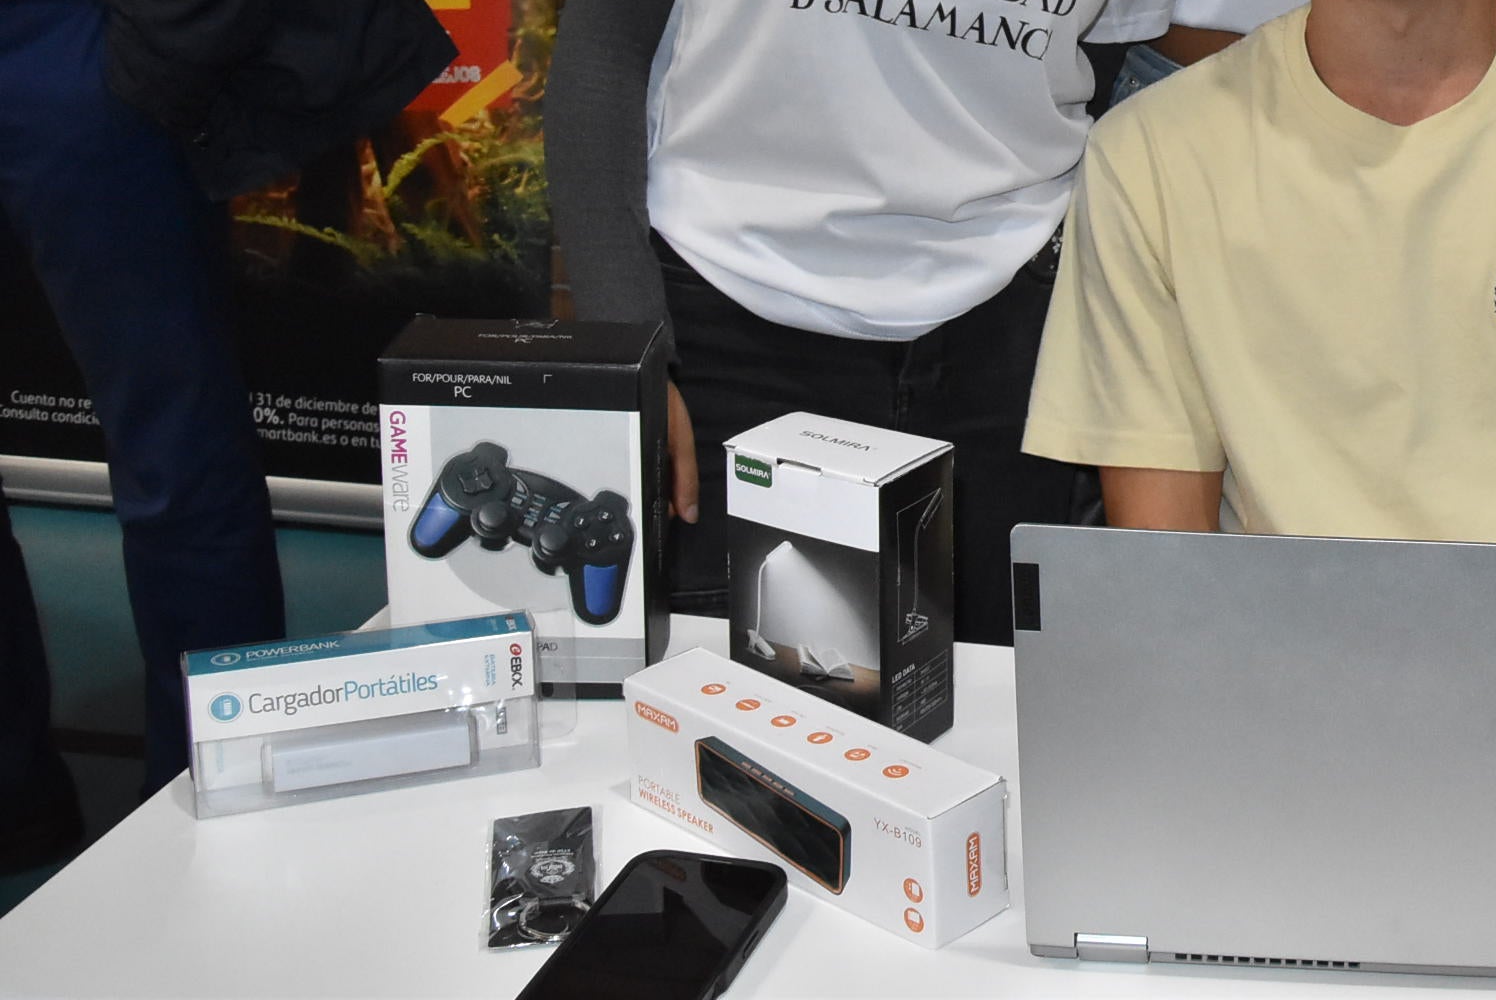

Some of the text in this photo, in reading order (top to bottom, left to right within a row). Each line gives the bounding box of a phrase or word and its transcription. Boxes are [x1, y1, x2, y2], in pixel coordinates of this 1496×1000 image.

[10, 390, 56, 407] Cuenta
[58, 397, 76, 408] no
[454, 386, 472, 399] PC
[0, 404, 49, 421] onsulta
[275, 395, 292, 409] de
[294, 396, 359, 414] diciembre
[361, 402, 379, 415] de
[288, 412, 319, 428] Para
[321, 419, 380, 433] personas
[351, 437, 367, 447] en
[799, 430, 871, 452] SOLMIRA
[736, 463, 769, 480] SOLMIRA
[245, 640, 340, 659] POWERBANK
[249, 672, 438, 716] CargadorPortátiles
[677, 807, 714, 833] SPEAKER
